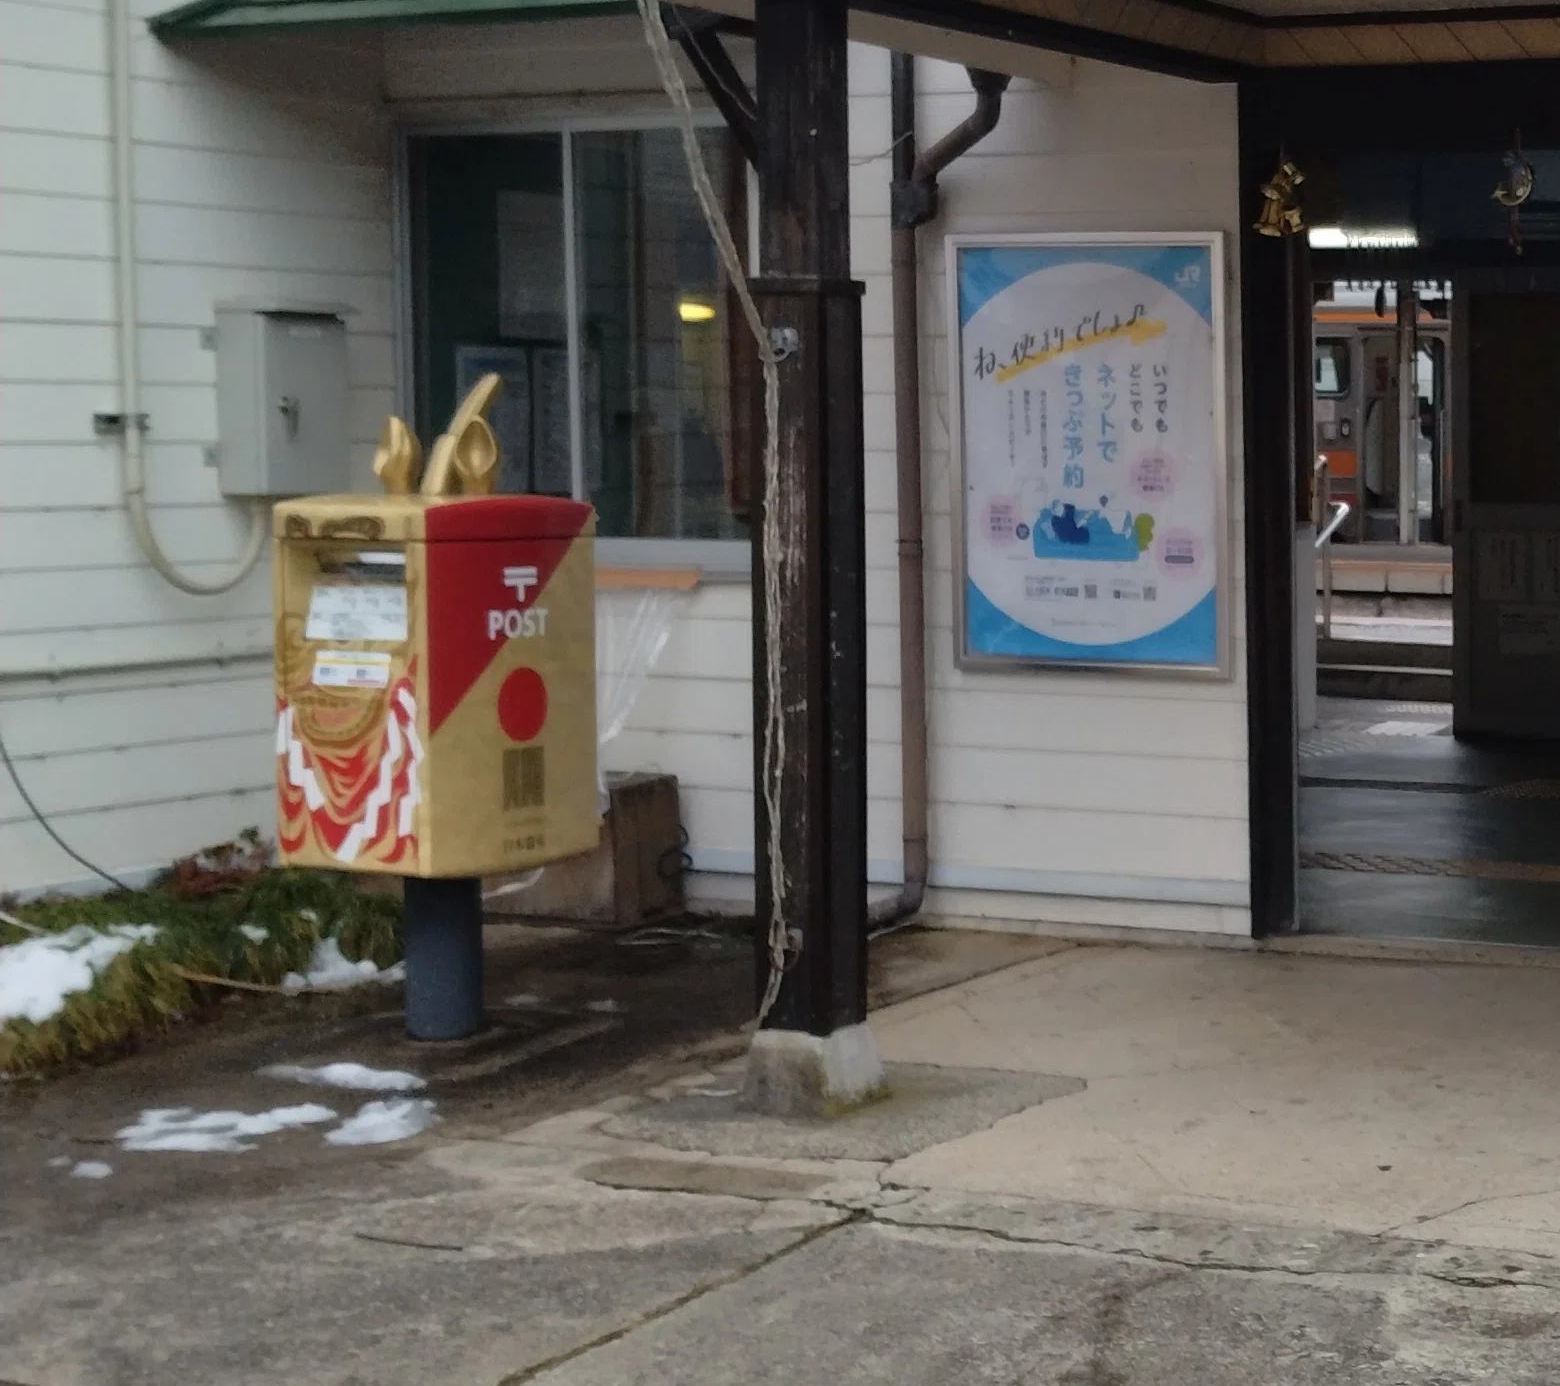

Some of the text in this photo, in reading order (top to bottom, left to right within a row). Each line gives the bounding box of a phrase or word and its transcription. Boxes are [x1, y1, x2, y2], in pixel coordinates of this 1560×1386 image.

[1062, 363, 1086, 489] きっぷ予約
[1095, 363, 1119, 463] ネットで
[1128, 362, 1145, 433] どこでも
[1152, 363, 1170, 434] いつでも
[487, 608, 550, 641] POST
